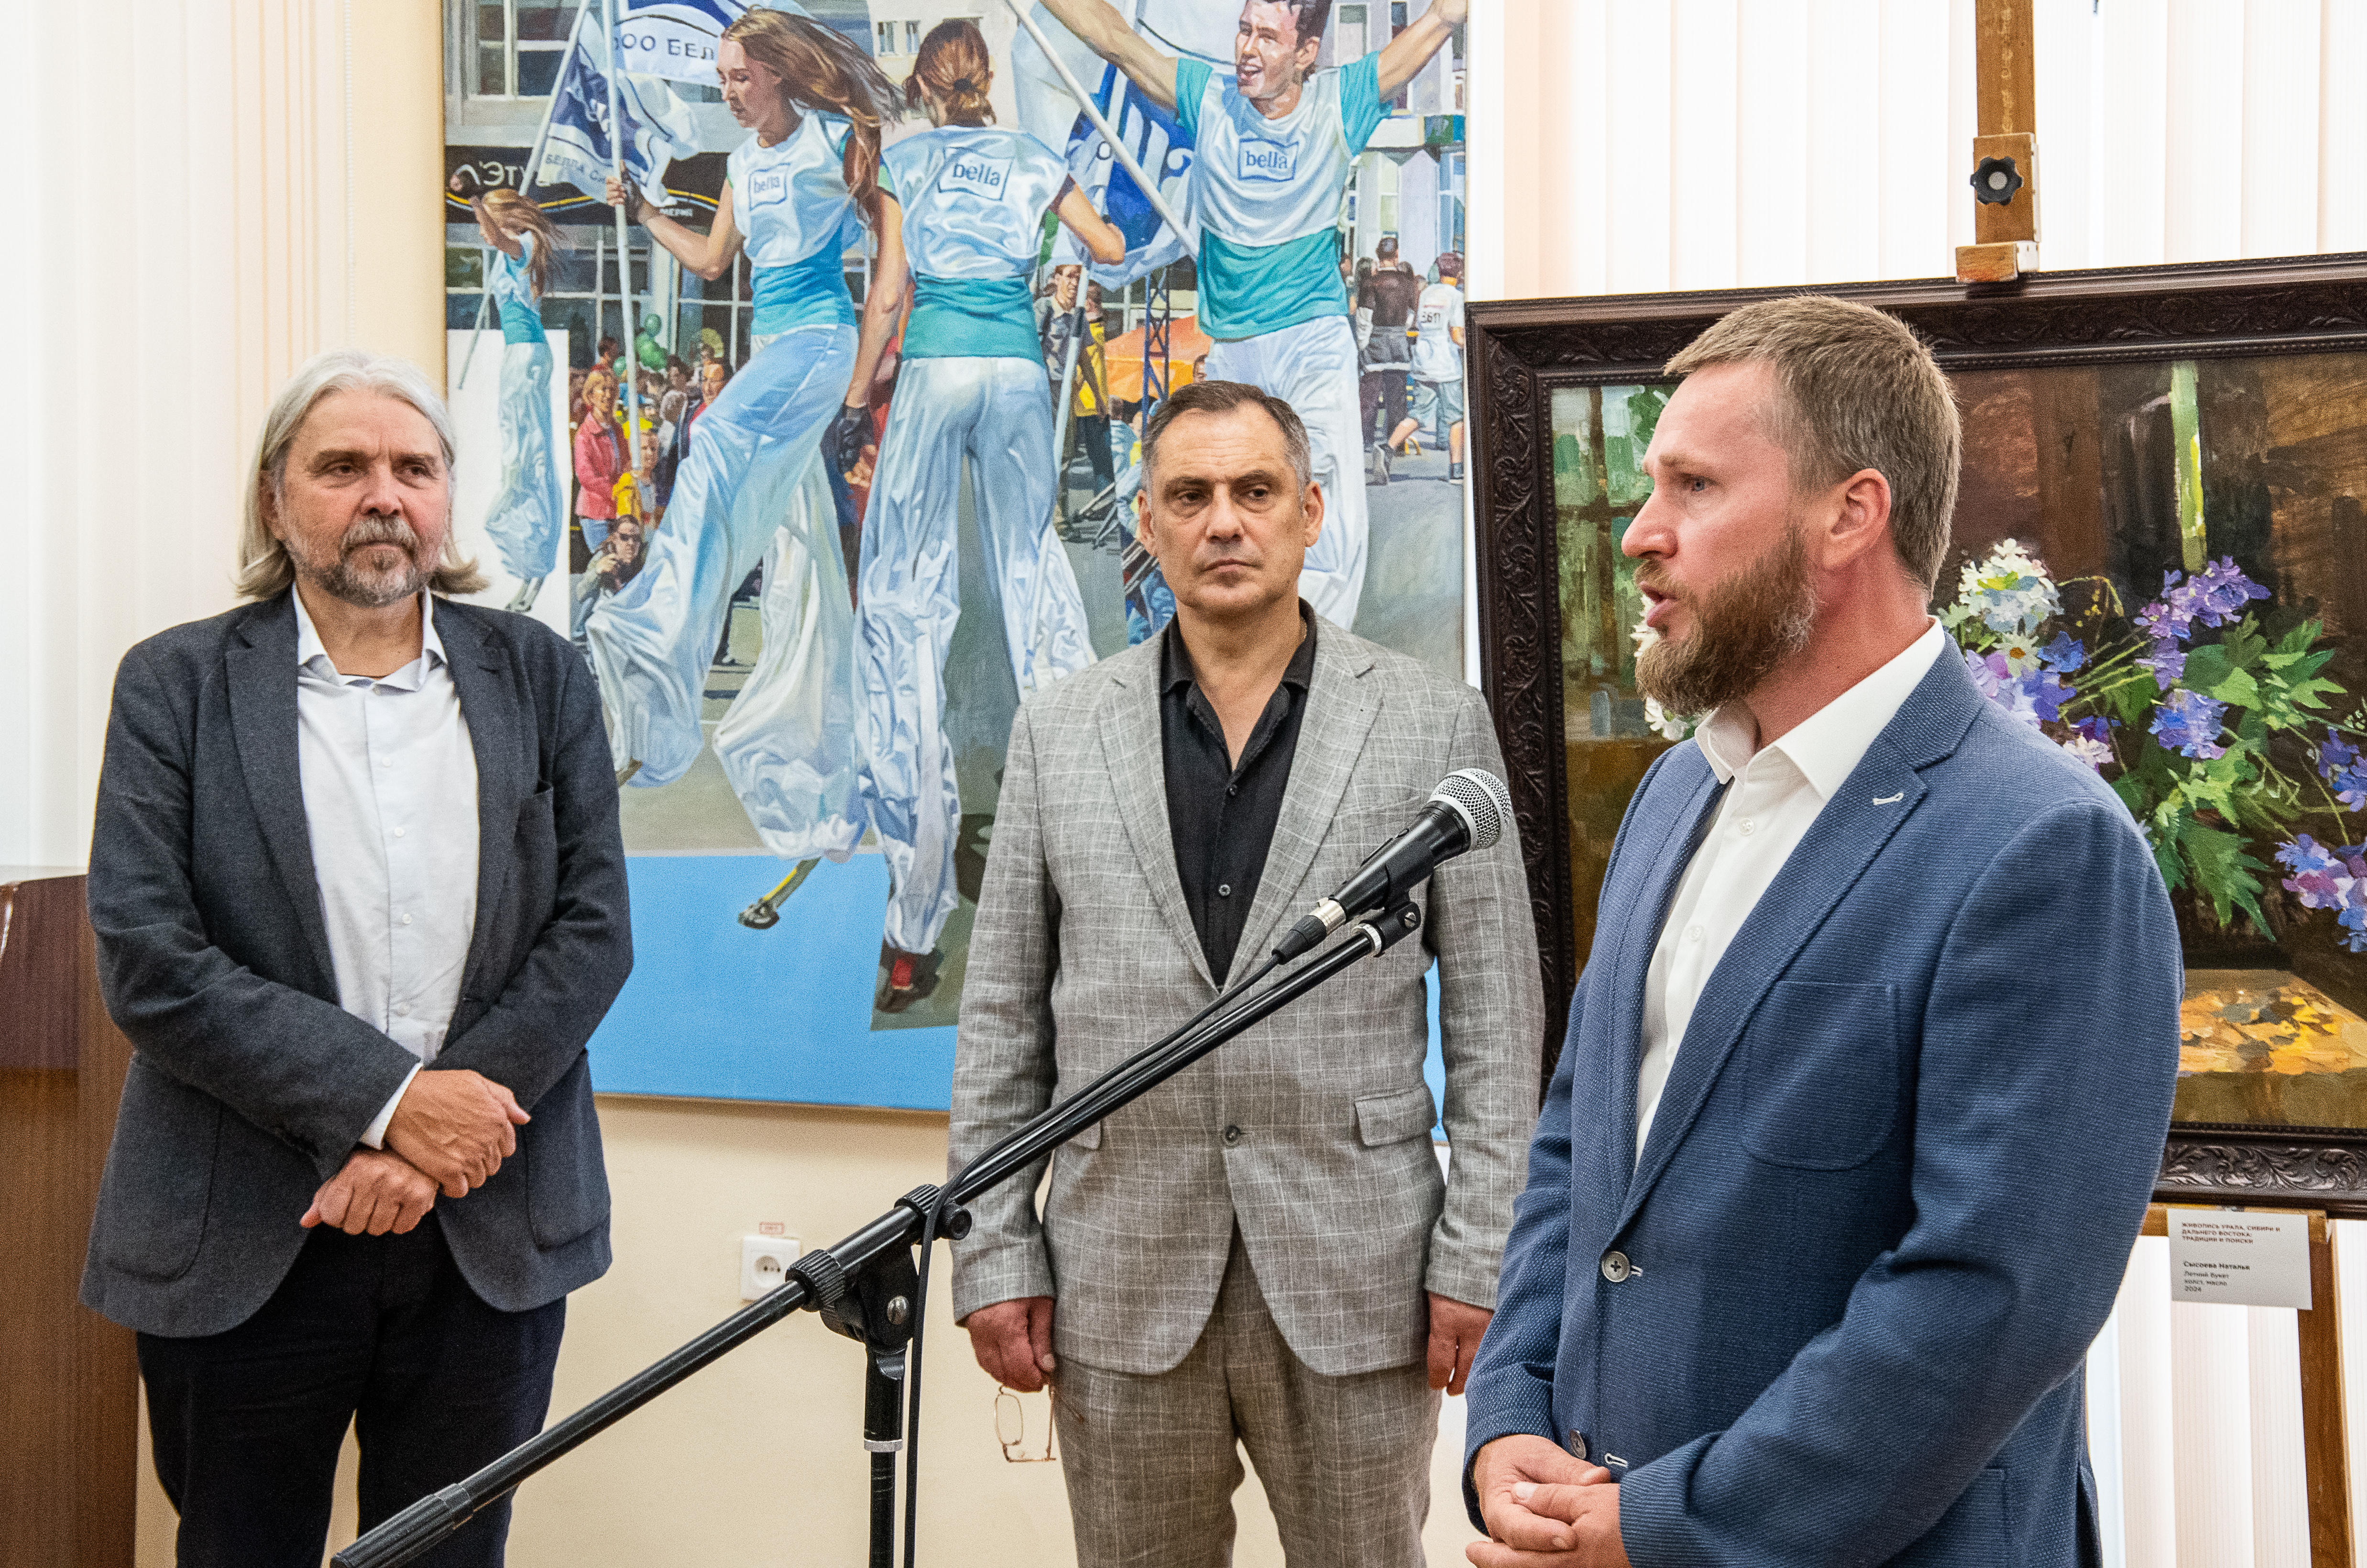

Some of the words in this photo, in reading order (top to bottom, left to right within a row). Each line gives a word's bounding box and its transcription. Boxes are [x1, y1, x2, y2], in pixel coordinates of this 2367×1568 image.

[614, 33, 656, 51] ОО
[1246, 151, 1287, 169] bella
[953, 163, 1000, 186] bella
